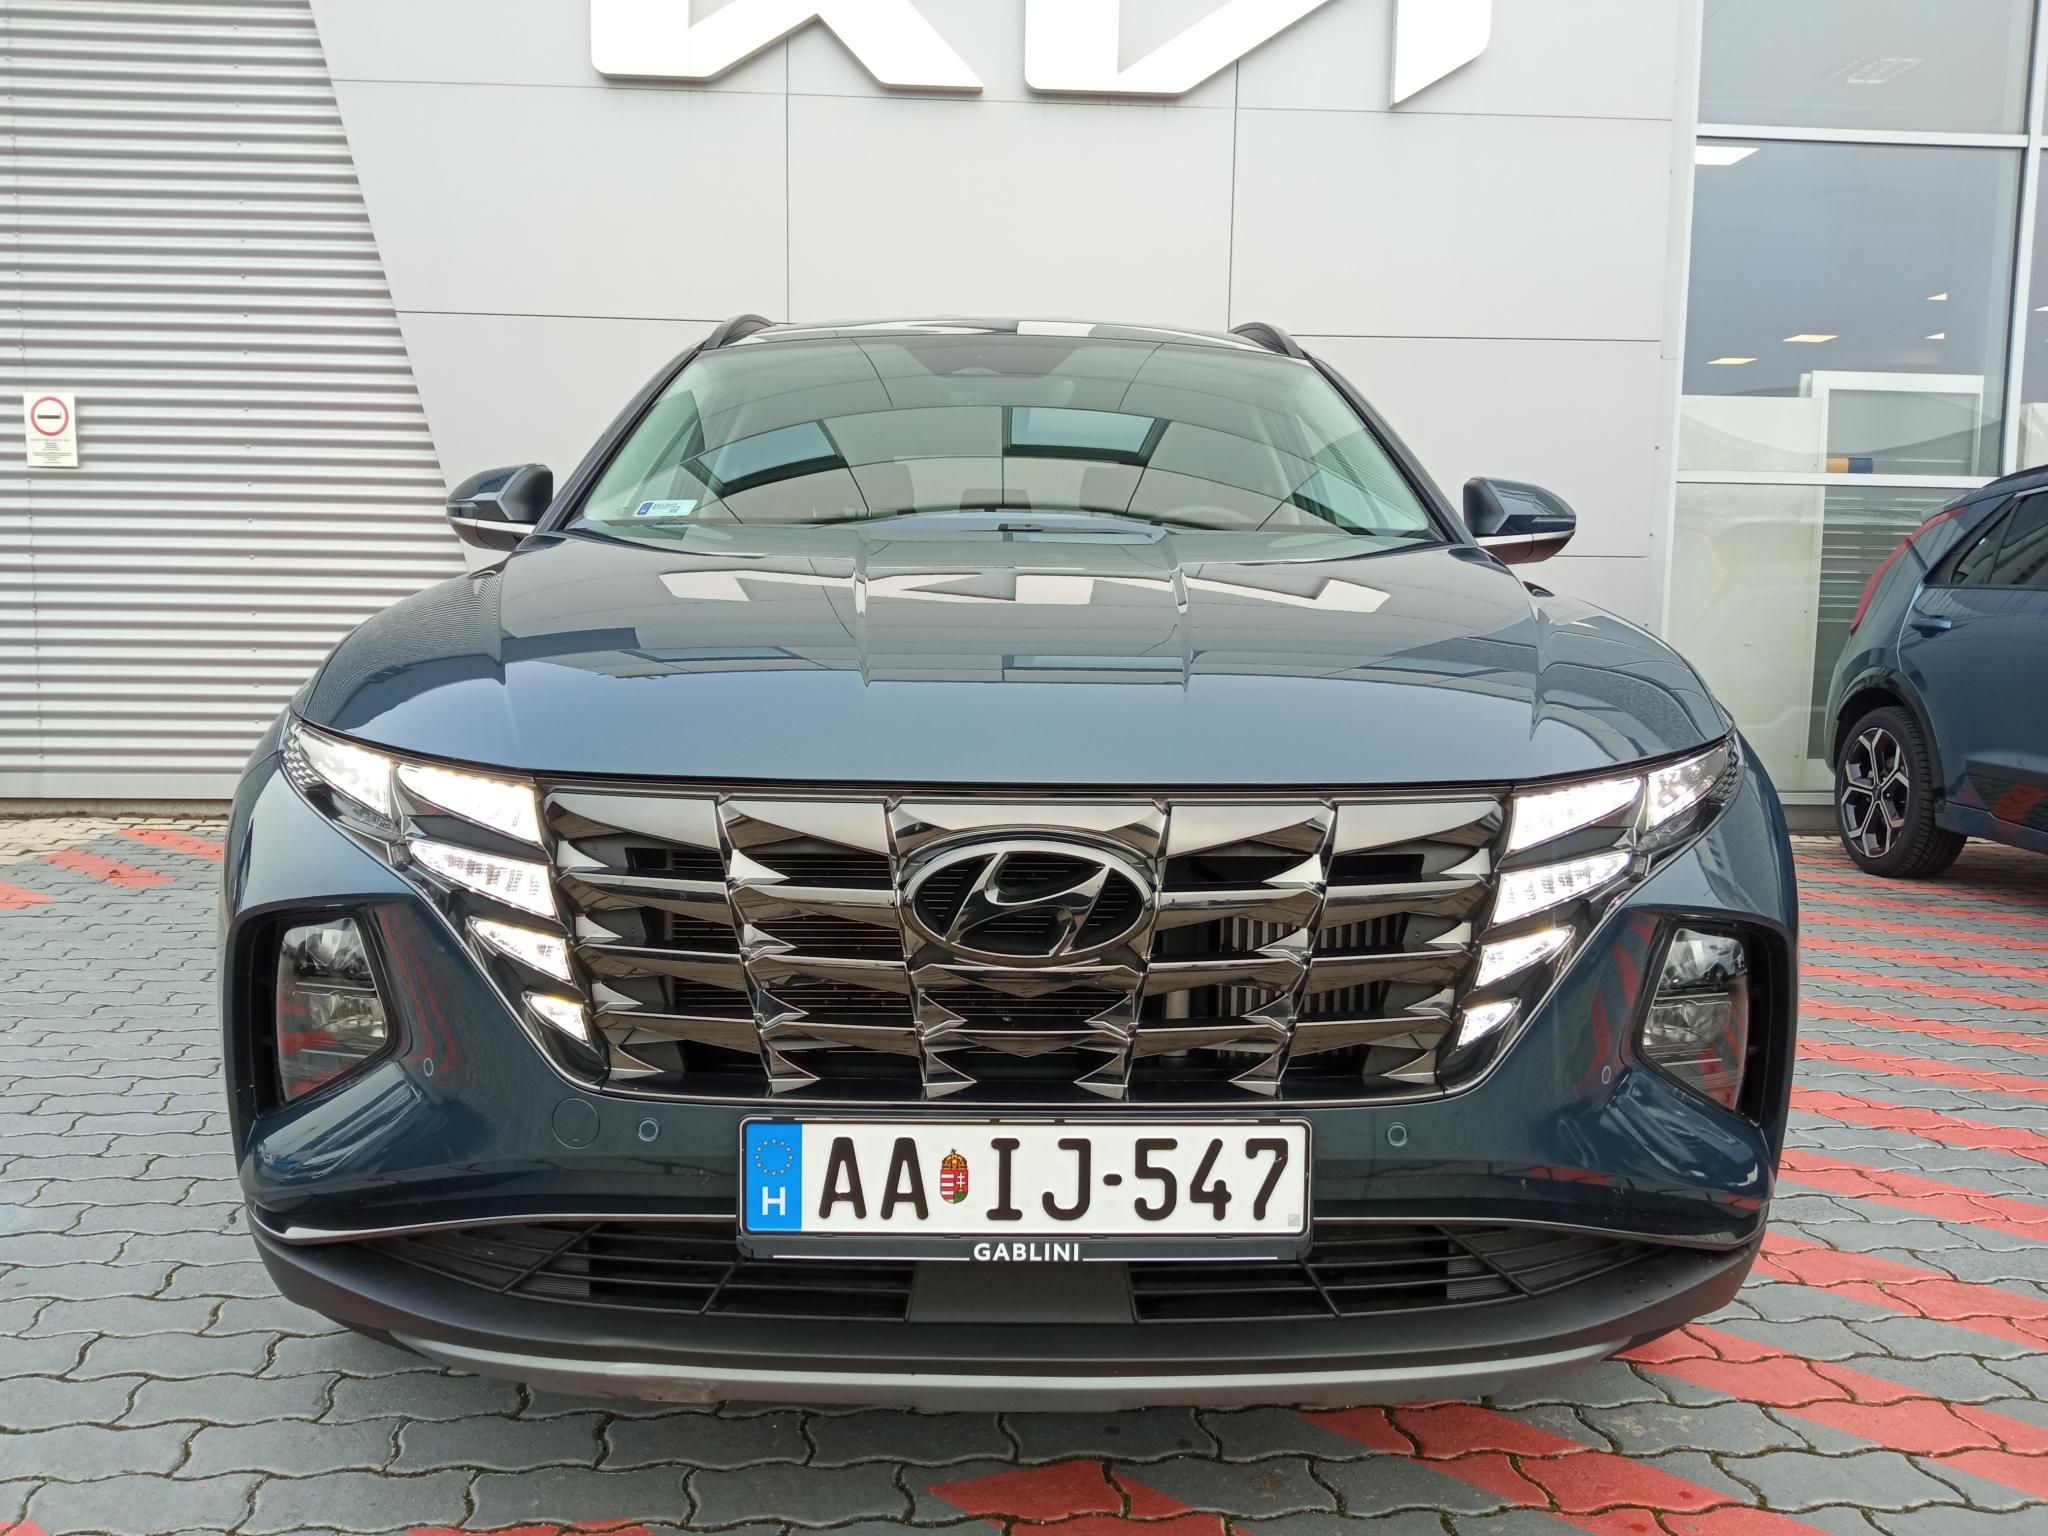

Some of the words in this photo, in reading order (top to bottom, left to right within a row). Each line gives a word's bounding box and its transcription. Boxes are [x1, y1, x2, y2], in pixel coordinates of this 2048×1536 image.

[818, 1136, 930, 1220] AA
[985, 1137, 1289, 1222] IJ-547
[762, 1186, 786, 1217] H
[972, 1242, 1081, 1263] GABLINI
